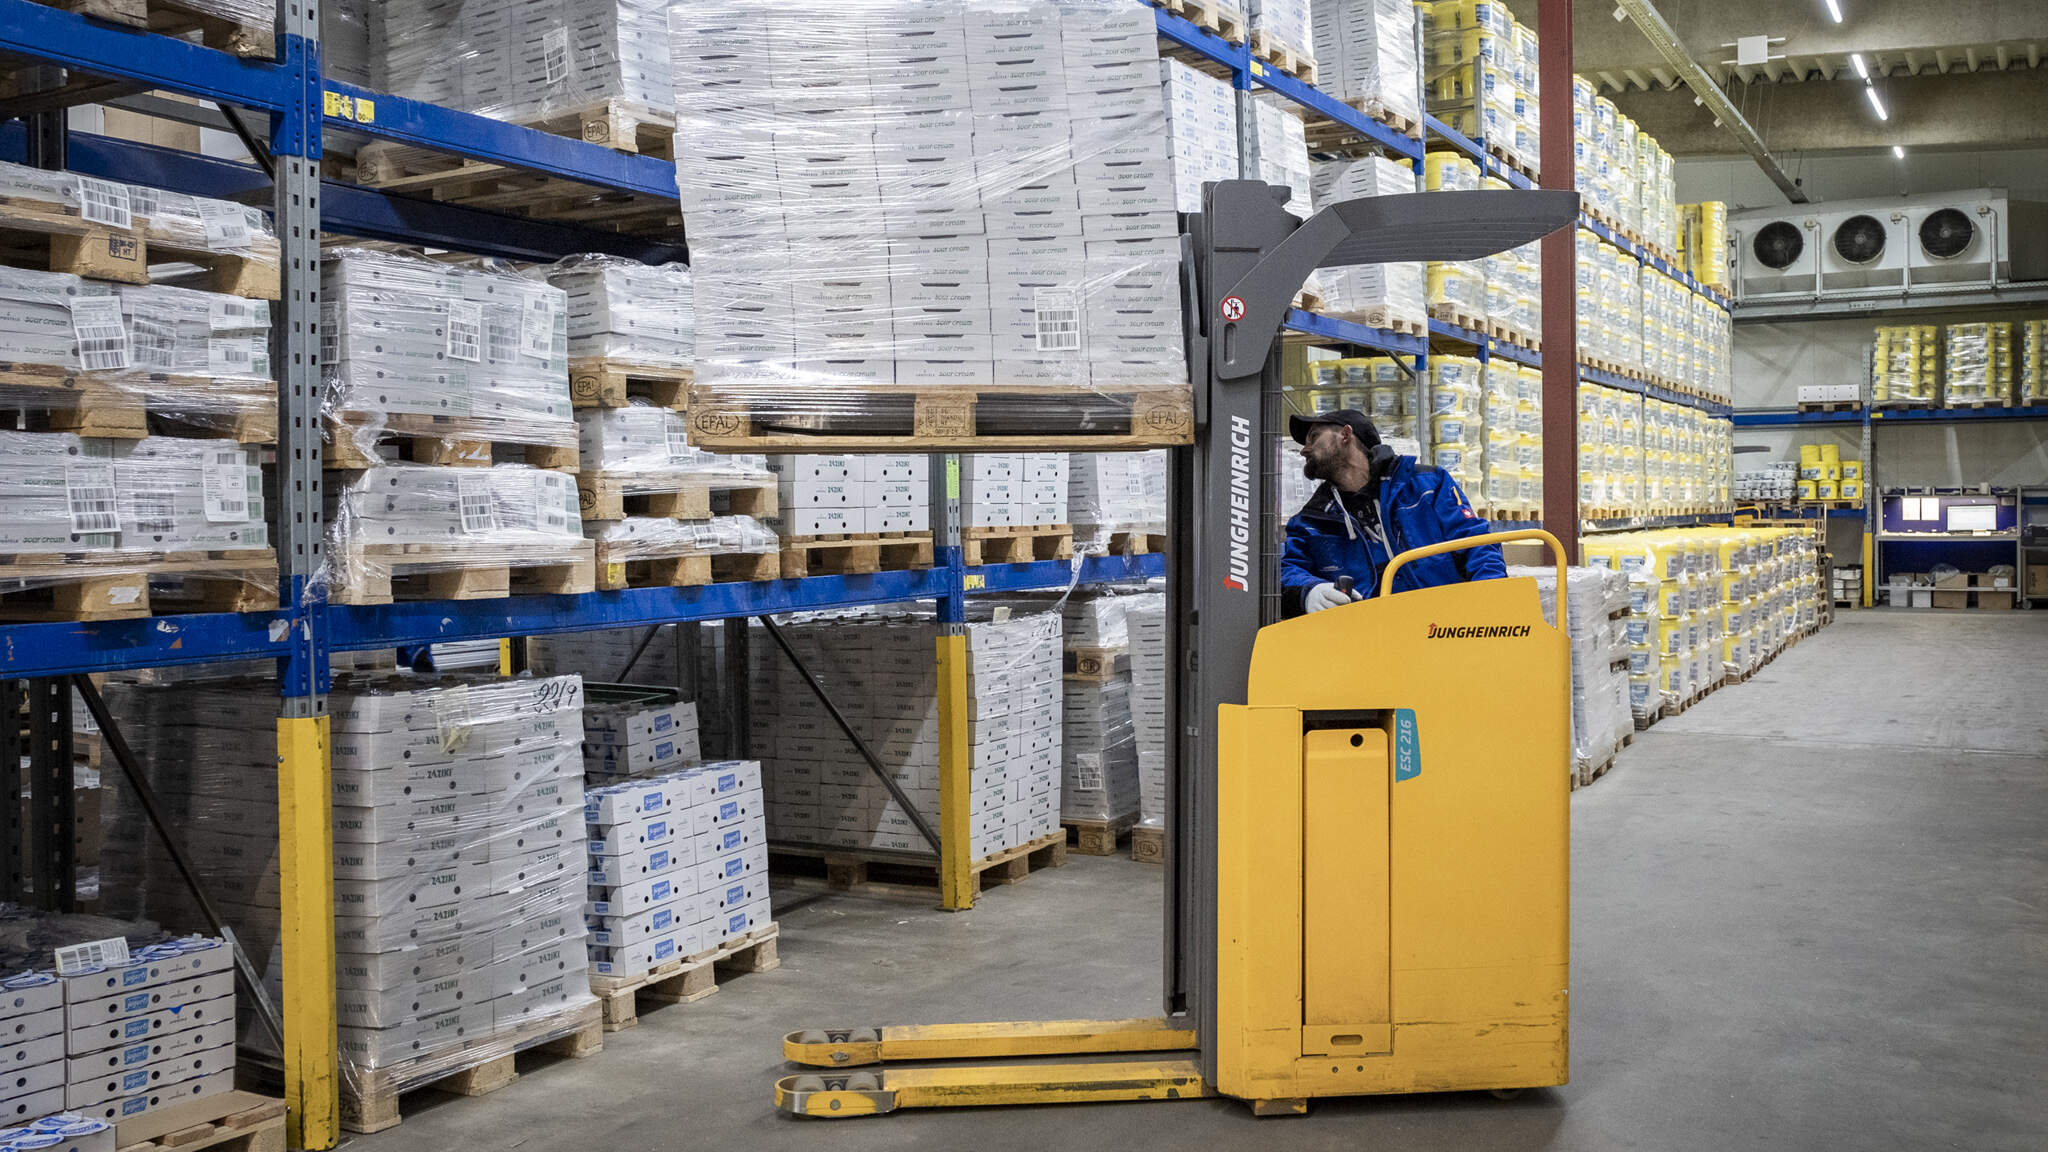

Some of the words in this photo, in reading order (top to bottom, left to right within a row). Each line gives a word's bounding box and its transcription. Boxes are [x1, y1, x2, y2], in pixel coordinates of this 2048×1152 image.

[1225, 415, 1250, 592] JUNGHEINRICH
[1428, 624, 1531, 639] JUNGHEINRICH
[1400, 719, 1412, 744] 216
[1400, 746, 1412, 772] ESC
[427, 768, 454, 779] ZAZIKI
[431, 873, 457, 886] ZAZIKI
[433, 909, 459, 920] ZAZIKI
[433, 980, 459, 993] ZAZIKI
